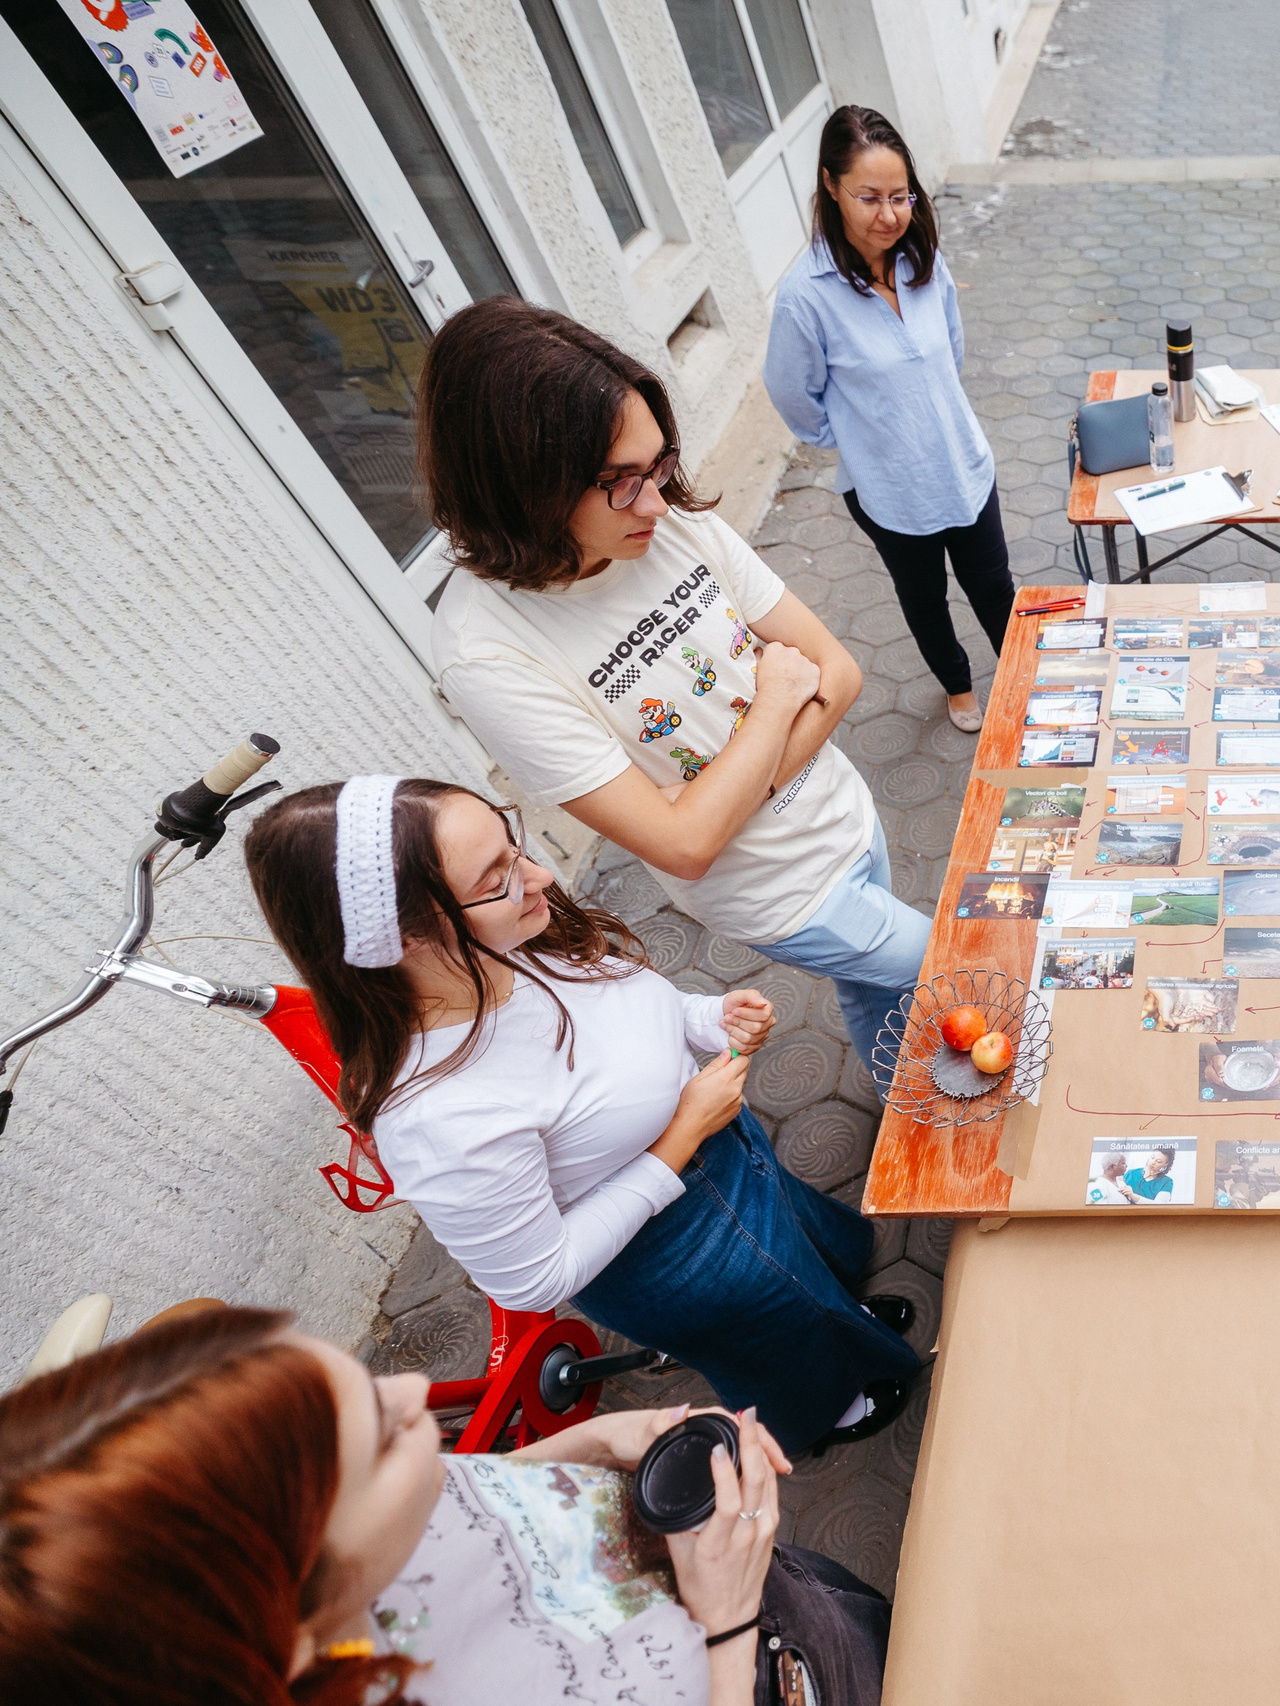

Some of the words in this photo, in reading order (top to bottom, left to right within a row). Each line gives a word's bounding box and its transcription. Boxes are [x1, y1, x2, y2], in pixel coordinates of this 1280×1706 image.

[588, 609, 668, 688] CHOOSE
[662, 564, 711, 608] YOUR
[639, 606, 702, 667] RACER
[1236, 1146, 1270, 1154] Conflicte
[518, 1514, 561, 1580] Garden
